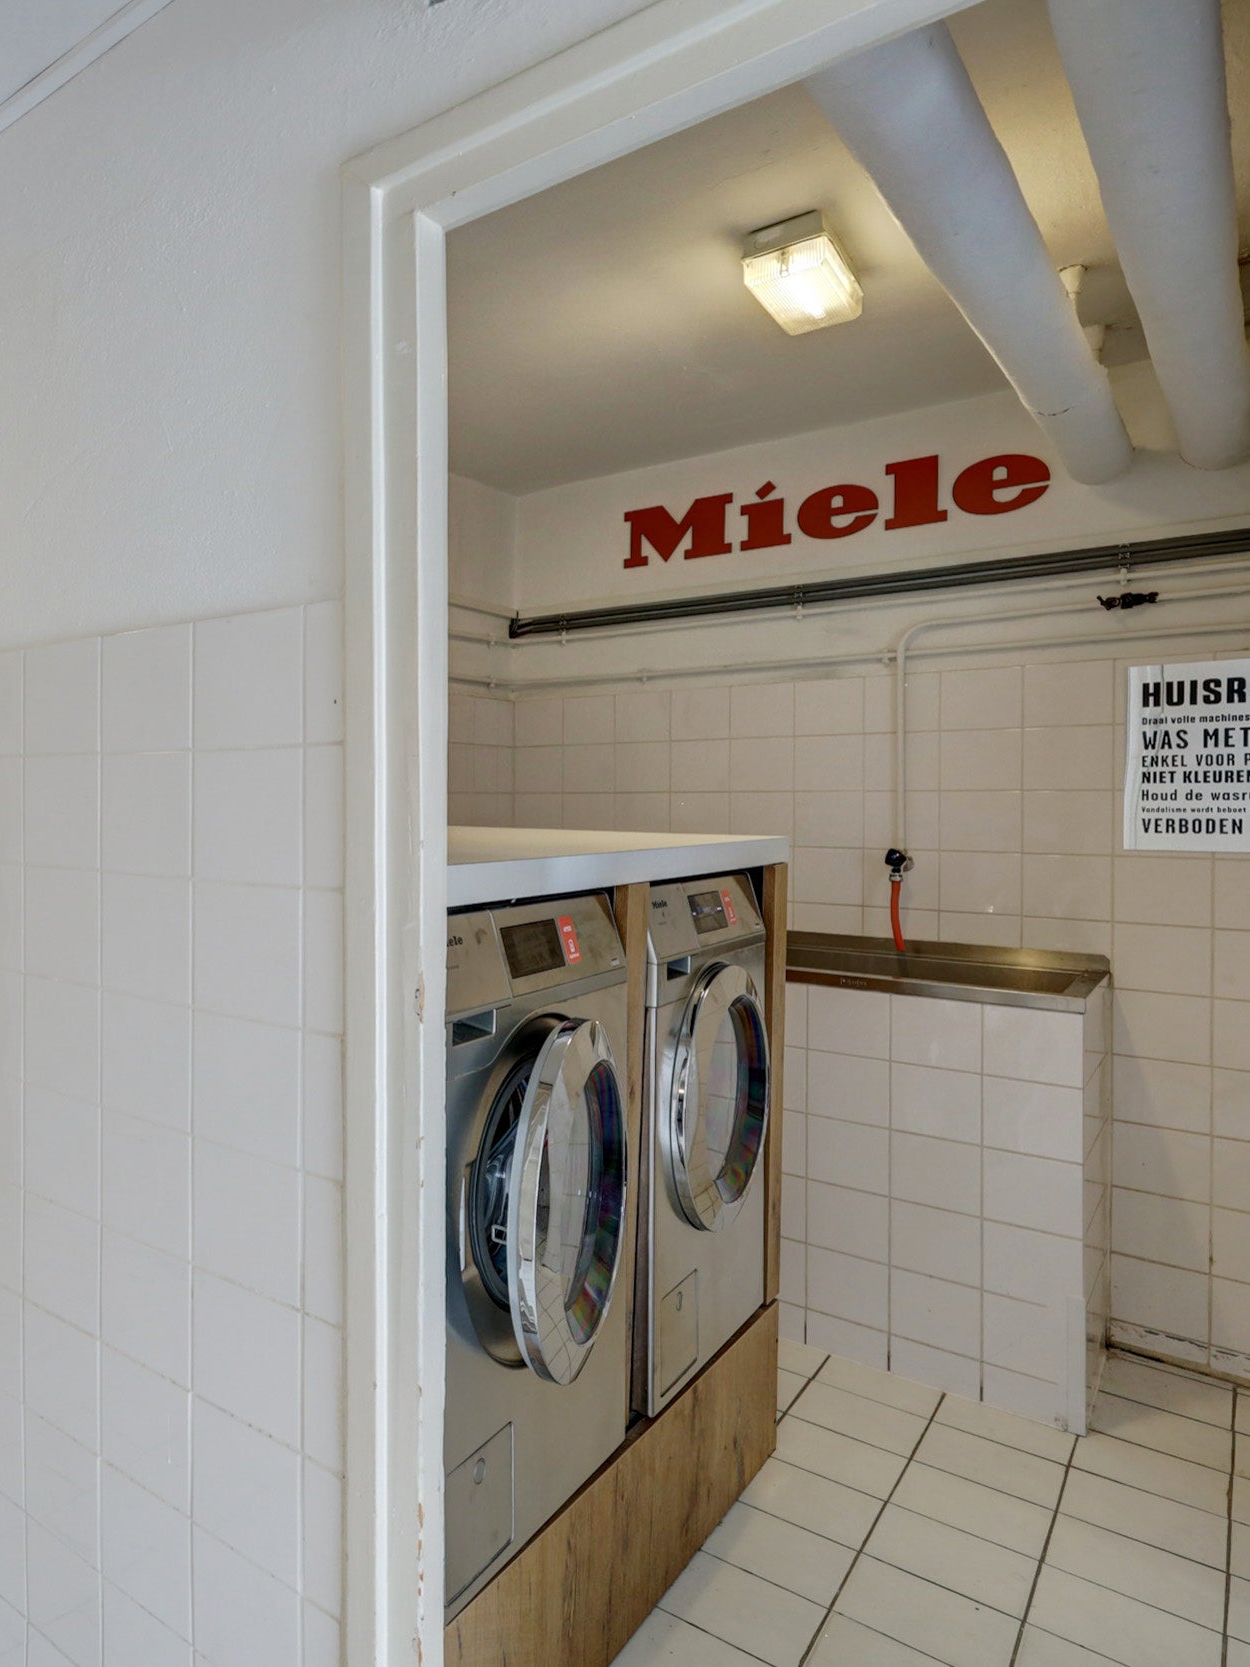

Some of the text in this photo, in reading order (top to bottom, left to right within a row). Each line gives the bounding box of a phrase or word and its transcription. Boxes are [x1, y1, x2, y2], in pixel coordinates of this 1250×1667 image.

[623, 454, 1051, 570] Miele
[1141, 676, 1247, 708] HUISR
[1170, 714, 1196, 725] volle
[1141, 726, 1250, 751] WAS MET
[1141, 754, 1188, 768] ENKEL
[1195, 753, 1236, 767] VOOR
[1141, 770, 1177, 784] NIET
[1141, 788, 1250, 801] Houd de wasr
[1141, 806, 1187, 814] Vandalisme
[1217, 805, 1247, 813] beboet
[1141, 817, 1243, 835] VERBODEN
[447, 935, 463, 948] ele
